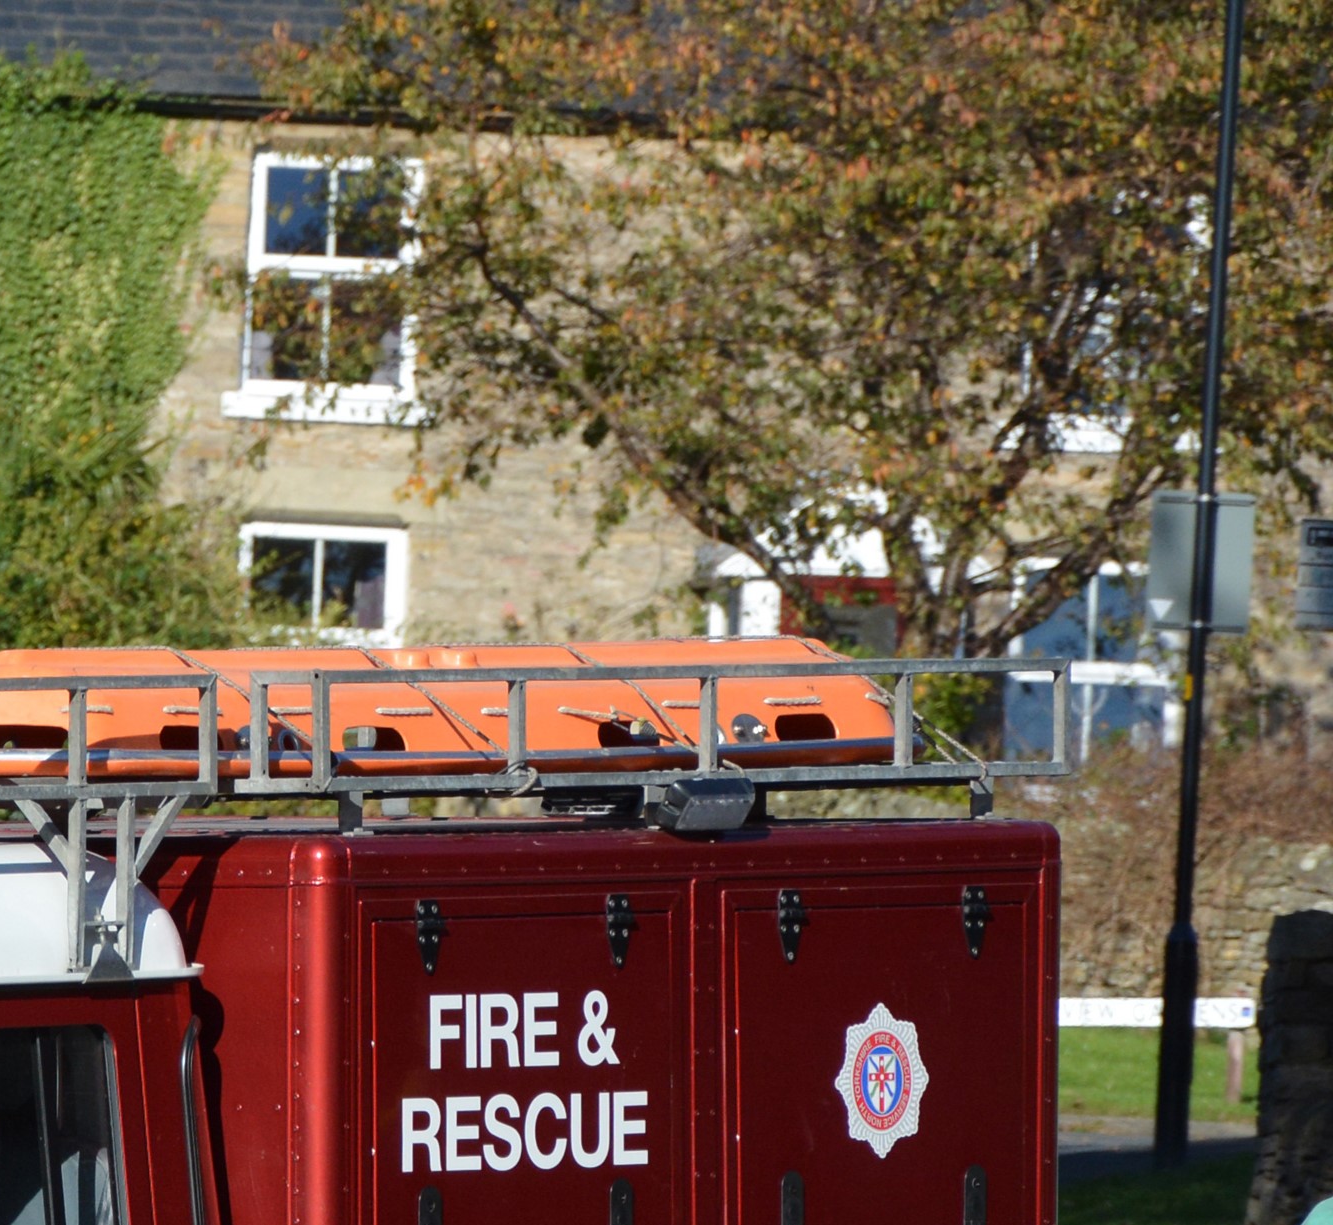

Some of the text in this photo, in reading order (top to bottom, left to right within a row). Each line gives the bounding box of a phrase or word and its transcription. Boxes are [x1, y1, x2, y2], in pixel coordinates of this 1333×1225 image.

[429, 989, 620, 1069] FIRE &
[874, 1033, 891, 1044] FIRE
[854, 1039, 873, 1101] YORKSHIRE
[897, 1045, 911, 1089] RESCUE
[401, 1090, 649, 1173] RESCUE
[859, 1102, 882, 1128] NORTH
[884, 1093, 908, 1128] SERVICE
